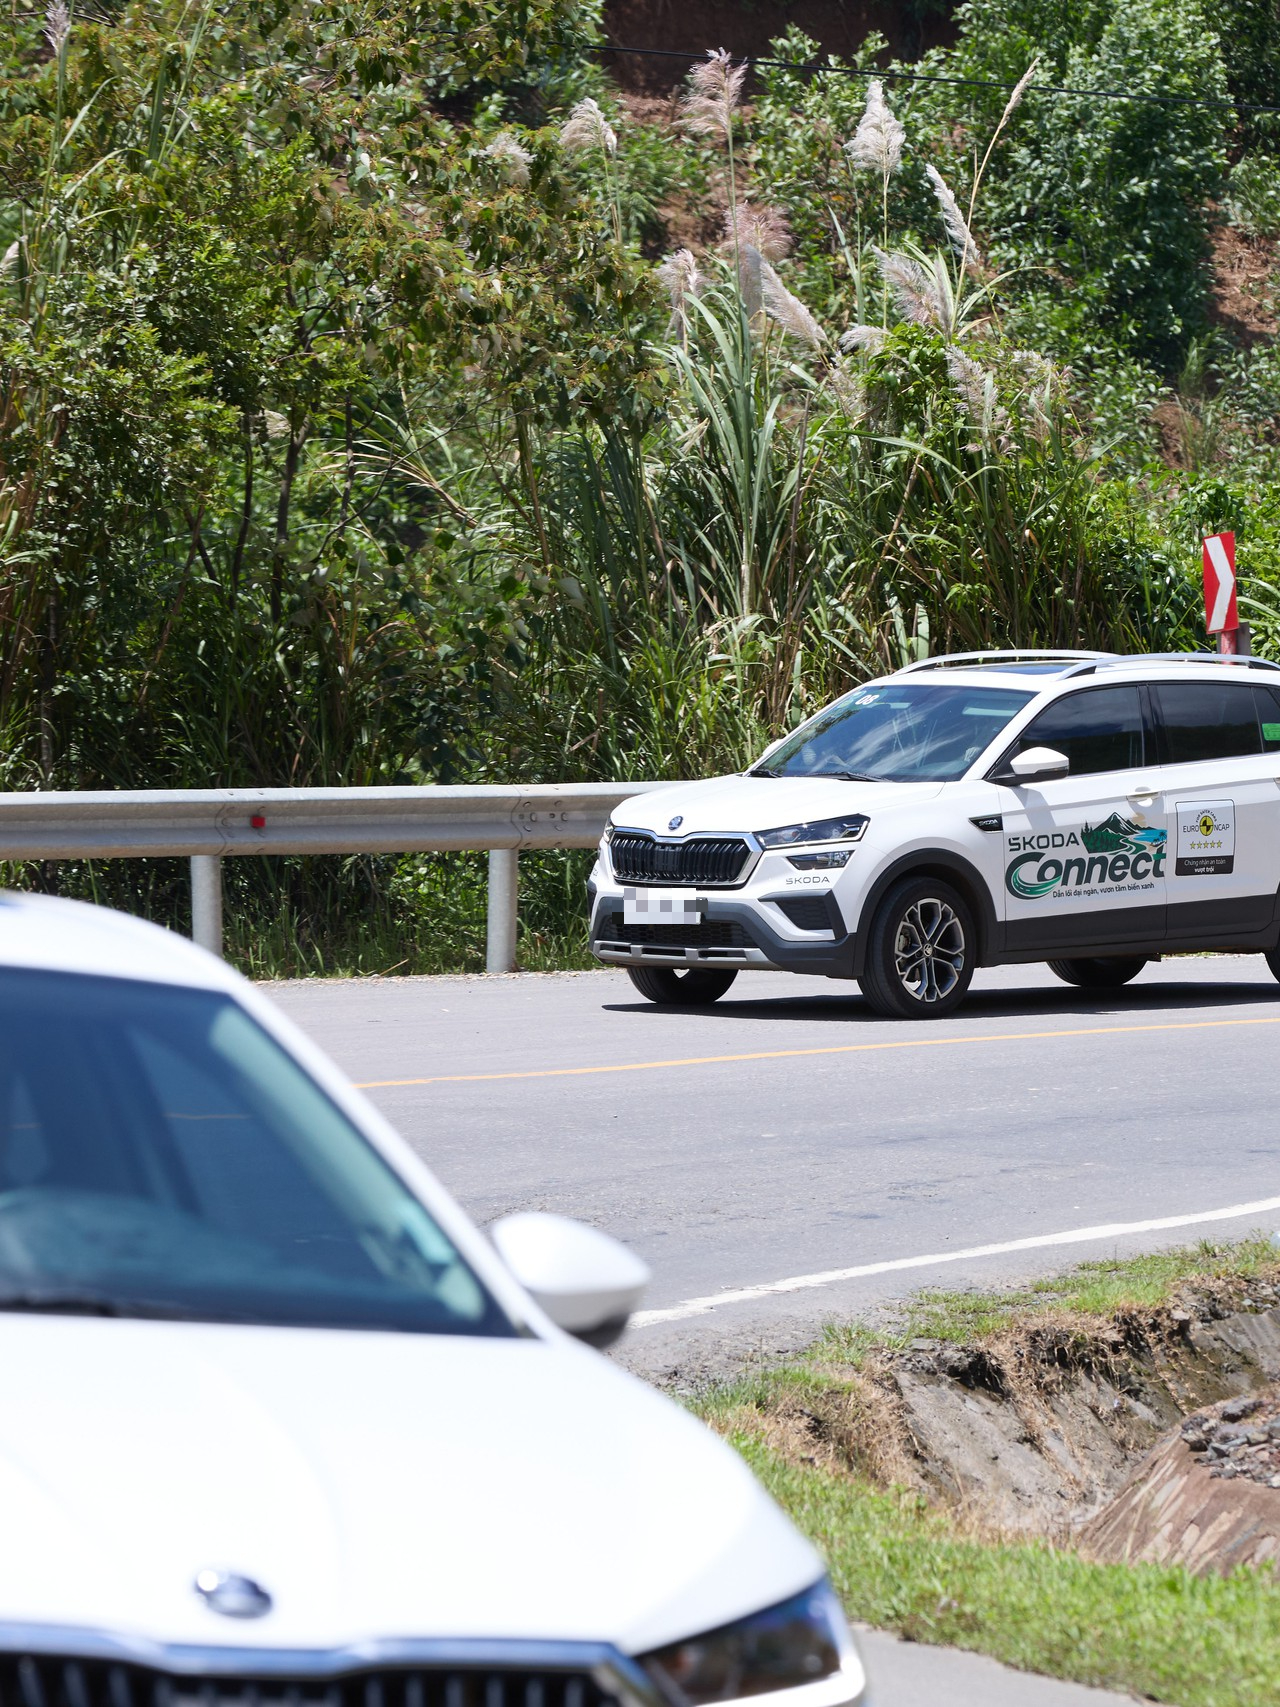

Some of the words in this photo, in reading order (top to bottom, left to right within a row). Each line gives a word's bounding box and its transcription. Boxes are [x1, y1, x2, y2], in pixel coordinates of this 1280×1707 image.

[855, 694, 879, 705] 08
[1183, 825, 1199, 833] EURO
[1214, 824, 1230, 832] NCAP
[1005, 843, 1167, 900] Connect
[1141, 882, 1155, 890] xanh
